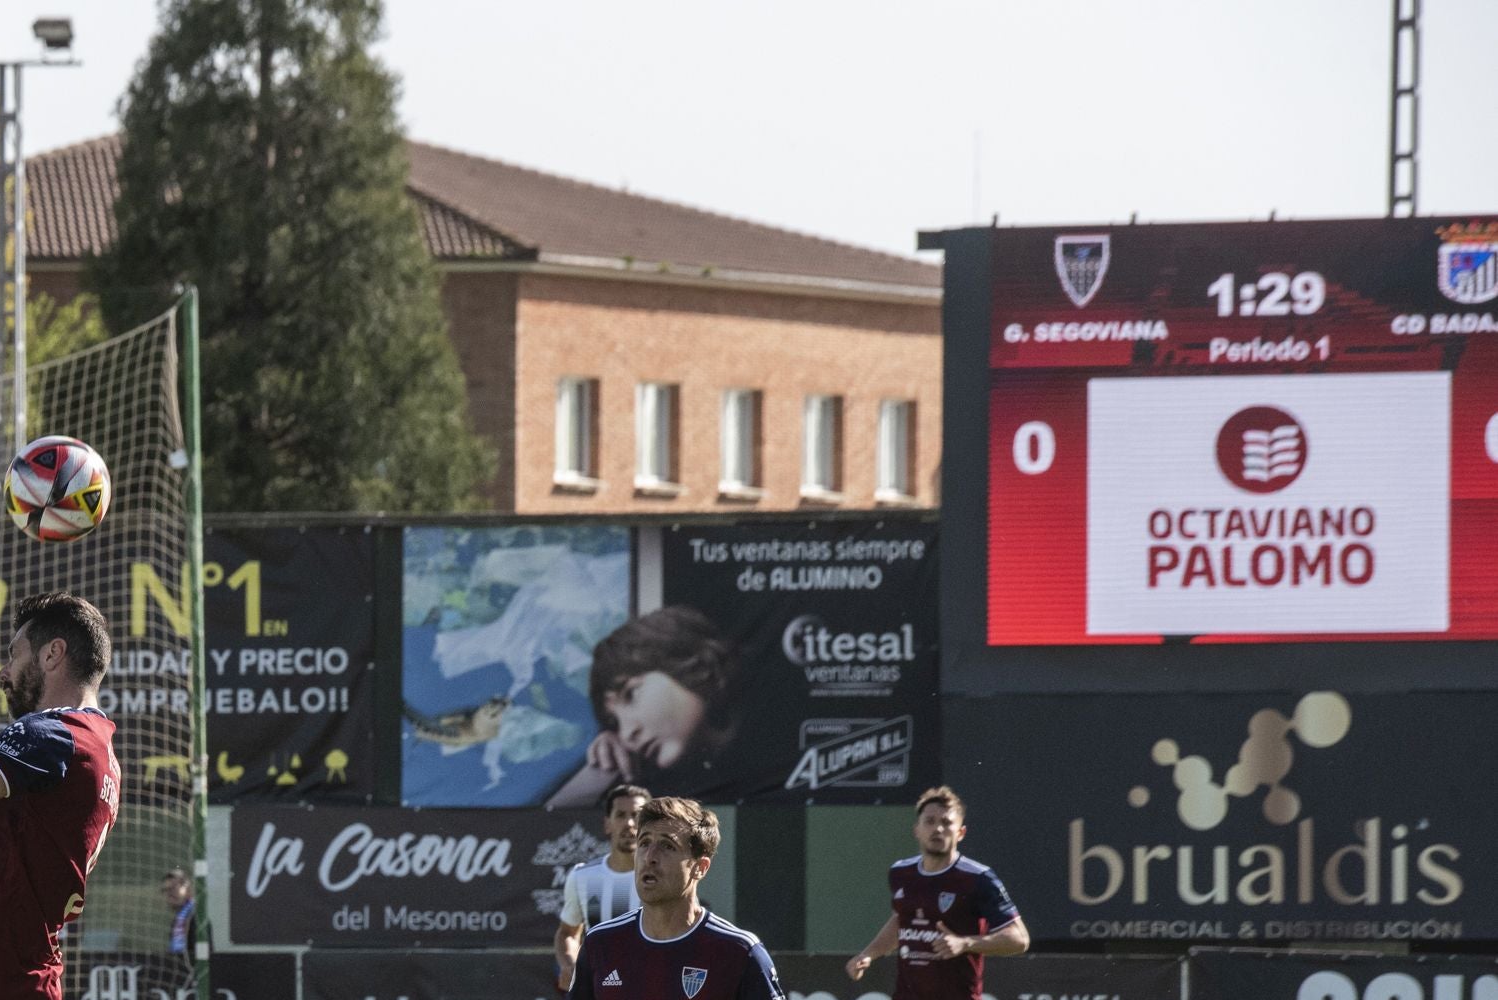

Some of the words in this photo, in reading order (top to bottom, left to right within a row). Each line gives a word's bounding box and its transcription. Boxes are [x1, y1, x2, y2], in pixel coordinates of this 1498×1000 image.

[1207, 271, 1327, 318] 1:29
[1033, 319, 1169, 342] SEGOVIANA
[1391, 313, 1427, 335] CD
[1209, 338, 1311, 364] Periodo
[1314, 335, 1330, 361] 1
[1012, 420, 1057, 475] 0
[1147, 507, 1376, 540] OCTAVIANO
[689, 538, 729, 563] Tus
[731, 538, 832, 563] ventanas
[834, 536, 926, 565] siempre
[736, 566, 767, 592] de
[769, 565, 884, 591] ALUMINIO
[1146, 543, 1375, 588] PALOMO
[263, 620, 289, 636] EN
[781, 613, 917, 667] Citesal
[210, 648, 231, 675] Y
[239, 646, 350, 675] PRECIO
[246, 822, 305, 898] la
[318, 823, 512, 893] Casona
[1069, 816, 1465, 907] brualdis
[332, 905, 370, 931] del
[384, 905, 508, 931] Mesonero
[1069, 919, 1230, 939] COMERCIAL
[1238, 921, 1258, 939] &
[1264, 918, 1463, 940] DISTRIBUCIÓN
